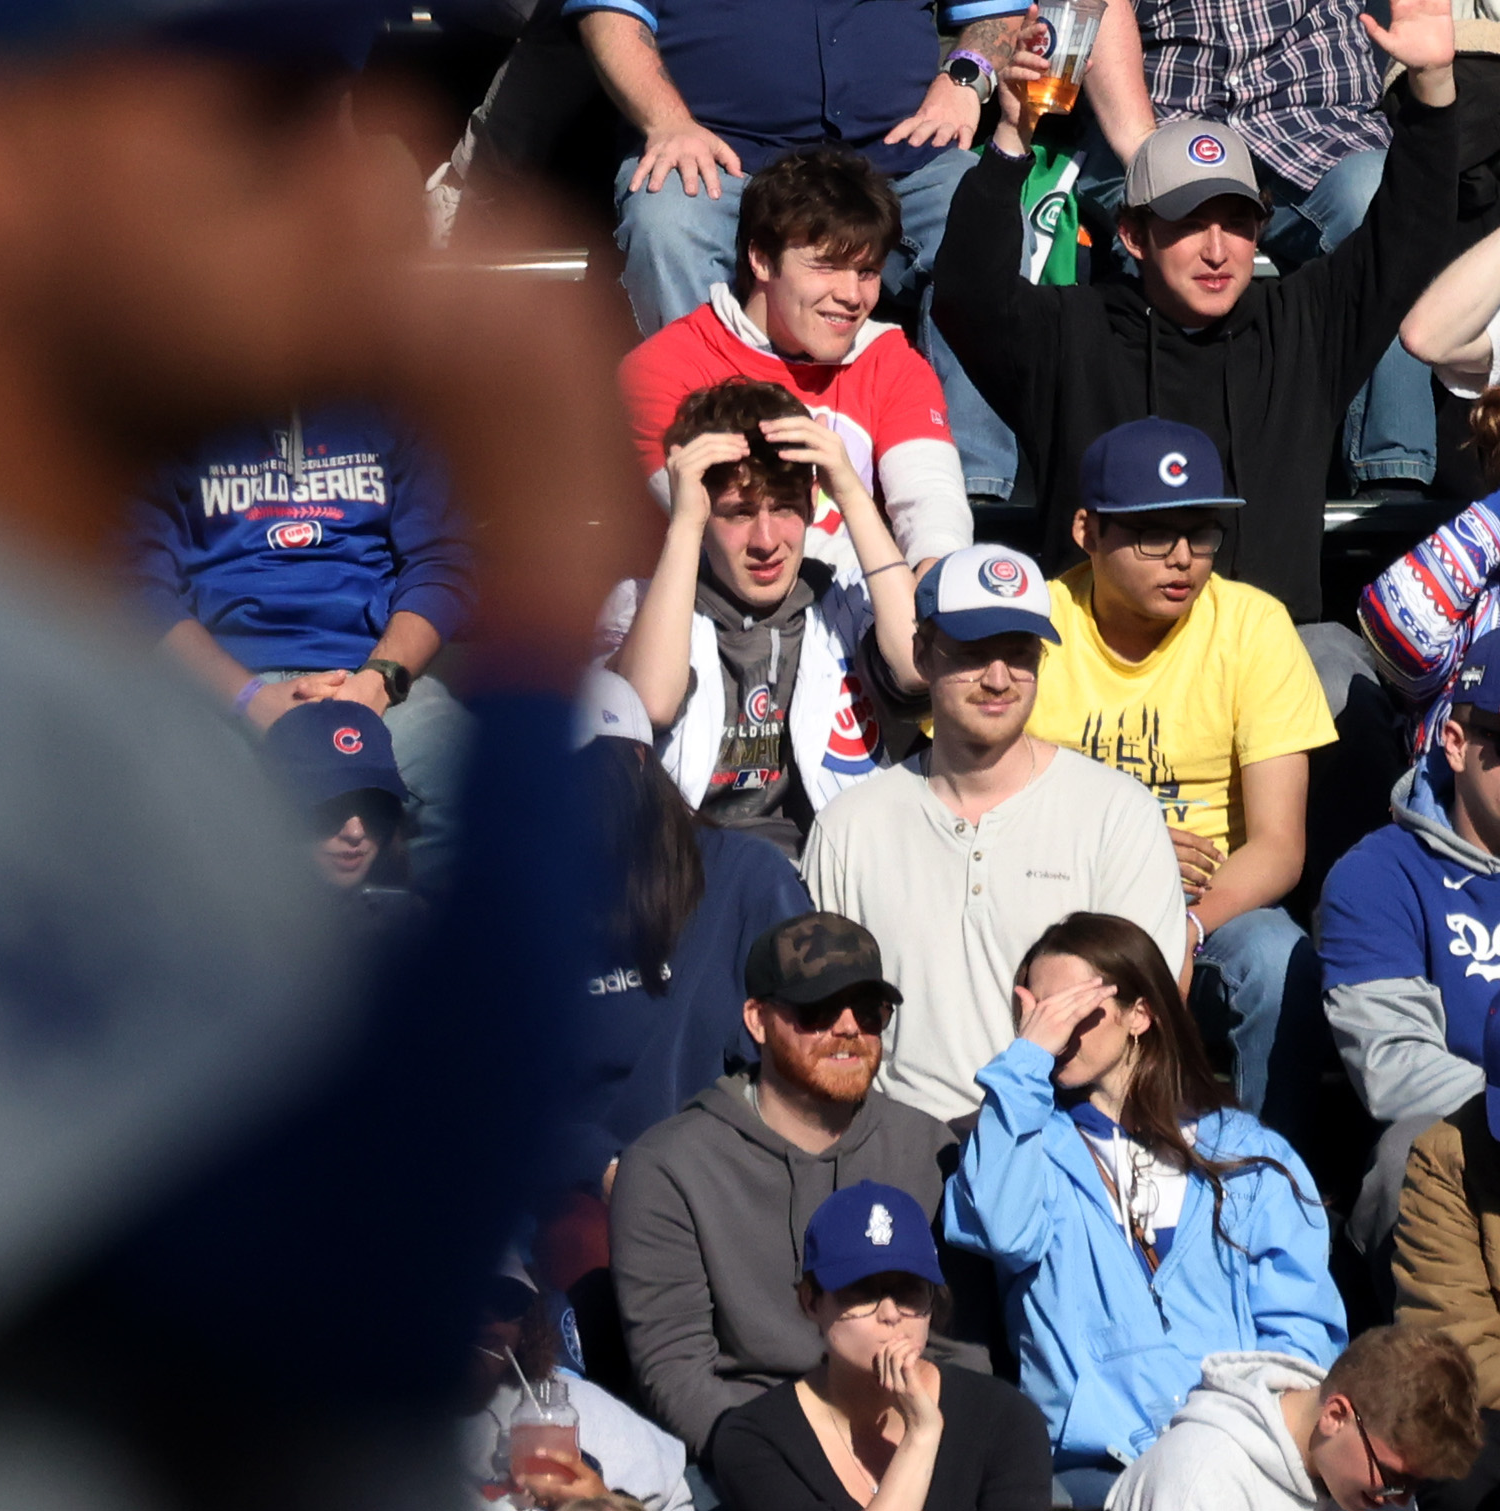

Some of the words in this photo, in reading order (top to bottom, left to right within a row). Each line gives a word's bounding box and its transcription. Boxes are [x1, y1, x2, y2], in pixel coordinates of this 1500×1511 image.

[240, 458, 297, 476] AUTHENT
[1158, 451, 1189, 487] C
[201, 468, 290, 518] WORLD
[291, 463, 386, 507] SERIES
[332, 727, 364, 755] C
